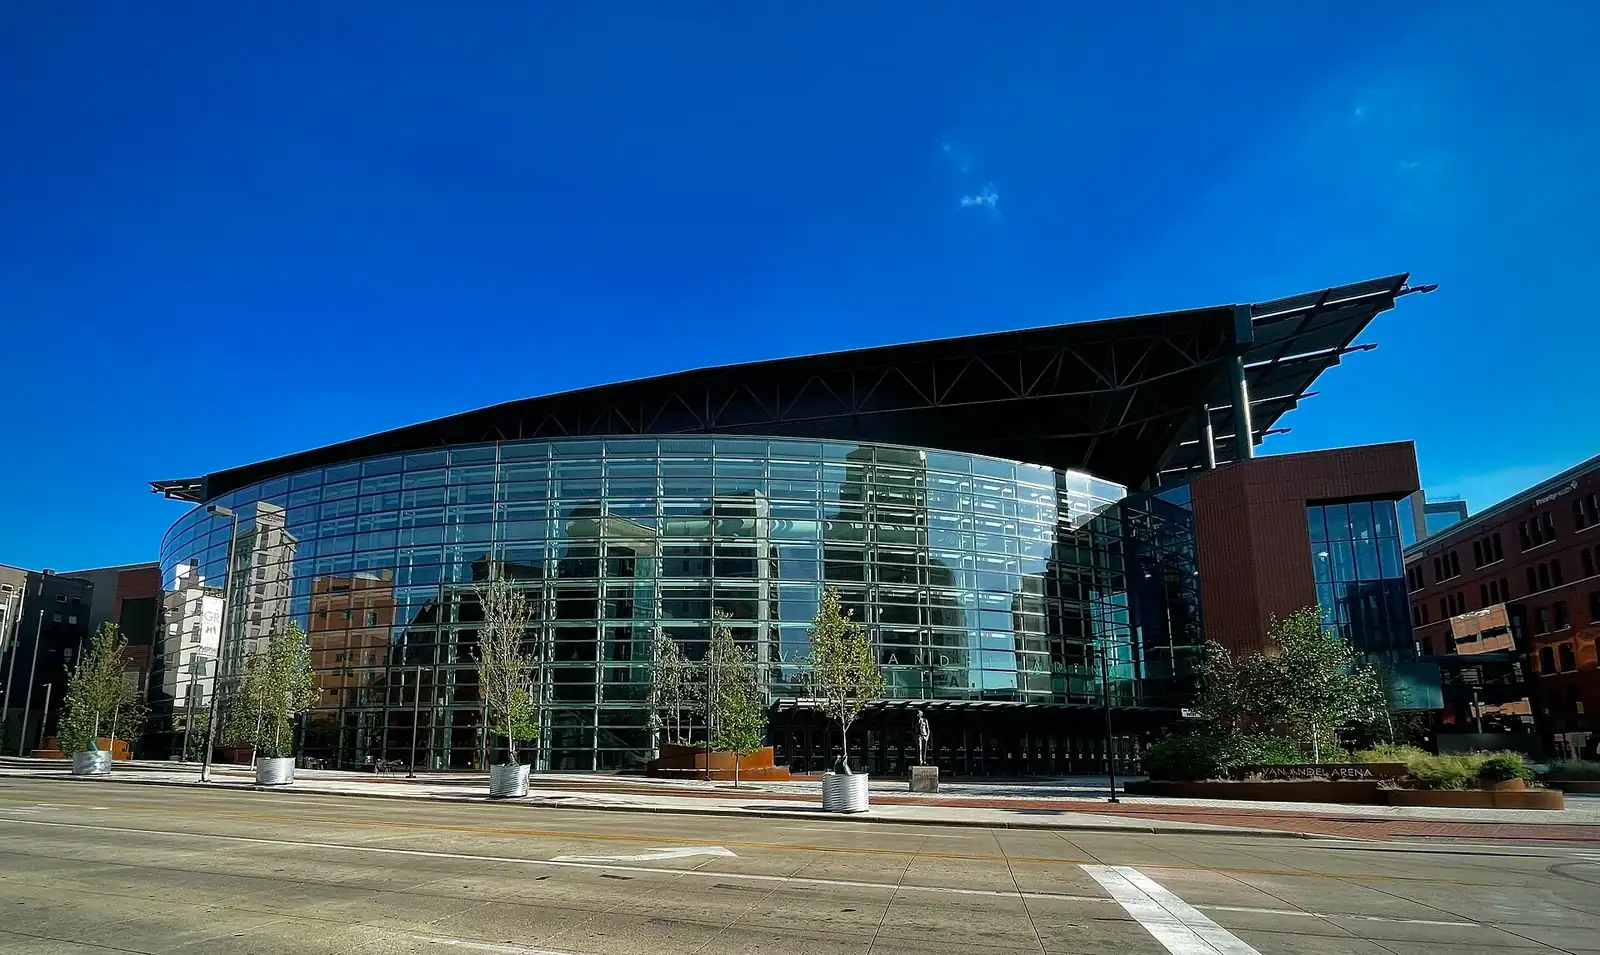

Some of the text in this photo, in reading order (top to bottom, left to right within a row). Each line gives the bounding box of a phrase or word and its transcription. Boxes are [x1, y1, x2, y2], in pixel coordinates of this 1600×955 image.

[1261, 767, 1373, 778] VAN ANDEL ARENA
